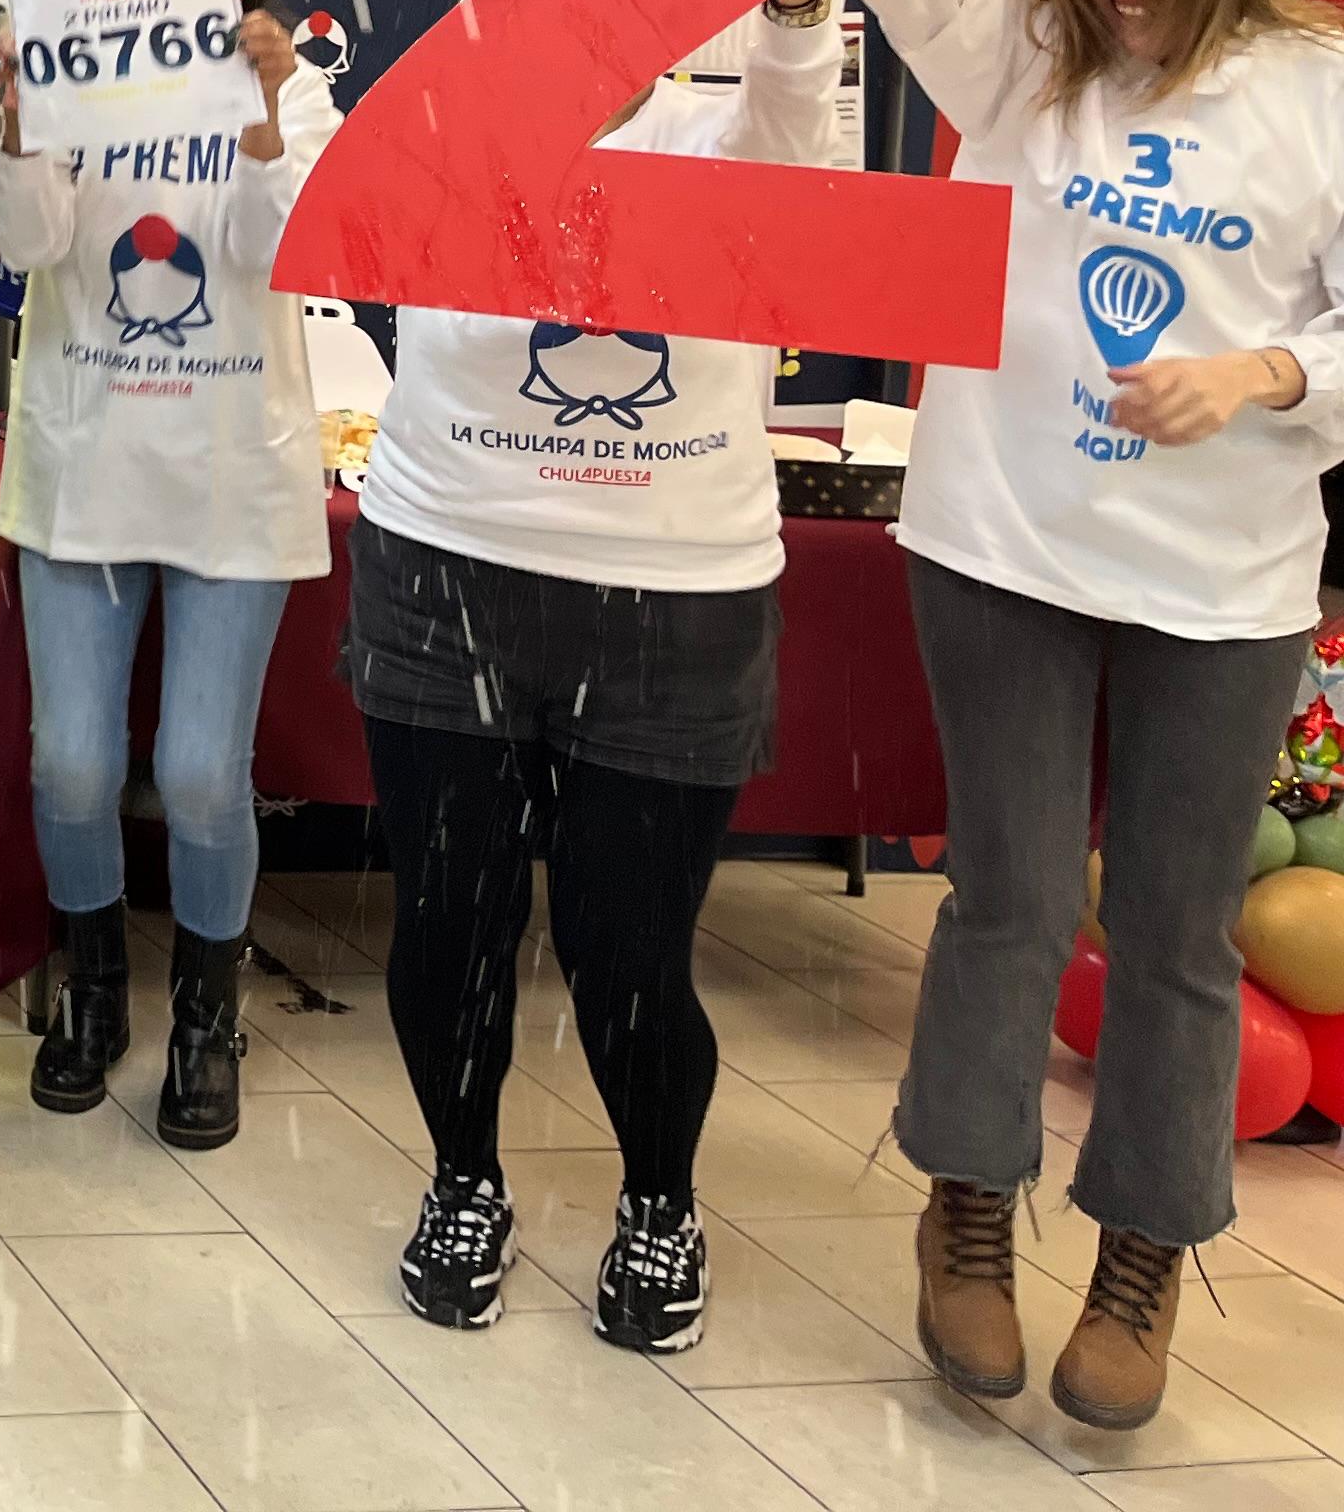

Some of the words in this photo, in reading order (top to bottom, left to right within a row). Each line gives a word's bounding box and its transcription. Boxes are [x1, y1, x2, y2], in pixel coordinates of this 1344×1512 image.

[21, 9, 238, 88] 06766
[1062, 174, 1255, 252] PREMIO
[451, 422, 472, 444] LA
[479, 428, 586, 458] CHULAPA
[593, 439, 625, 460] DE
[632, 430, 730, 462] MONCLOA
[538, 465, 653, 487] CHULAPUESTA
